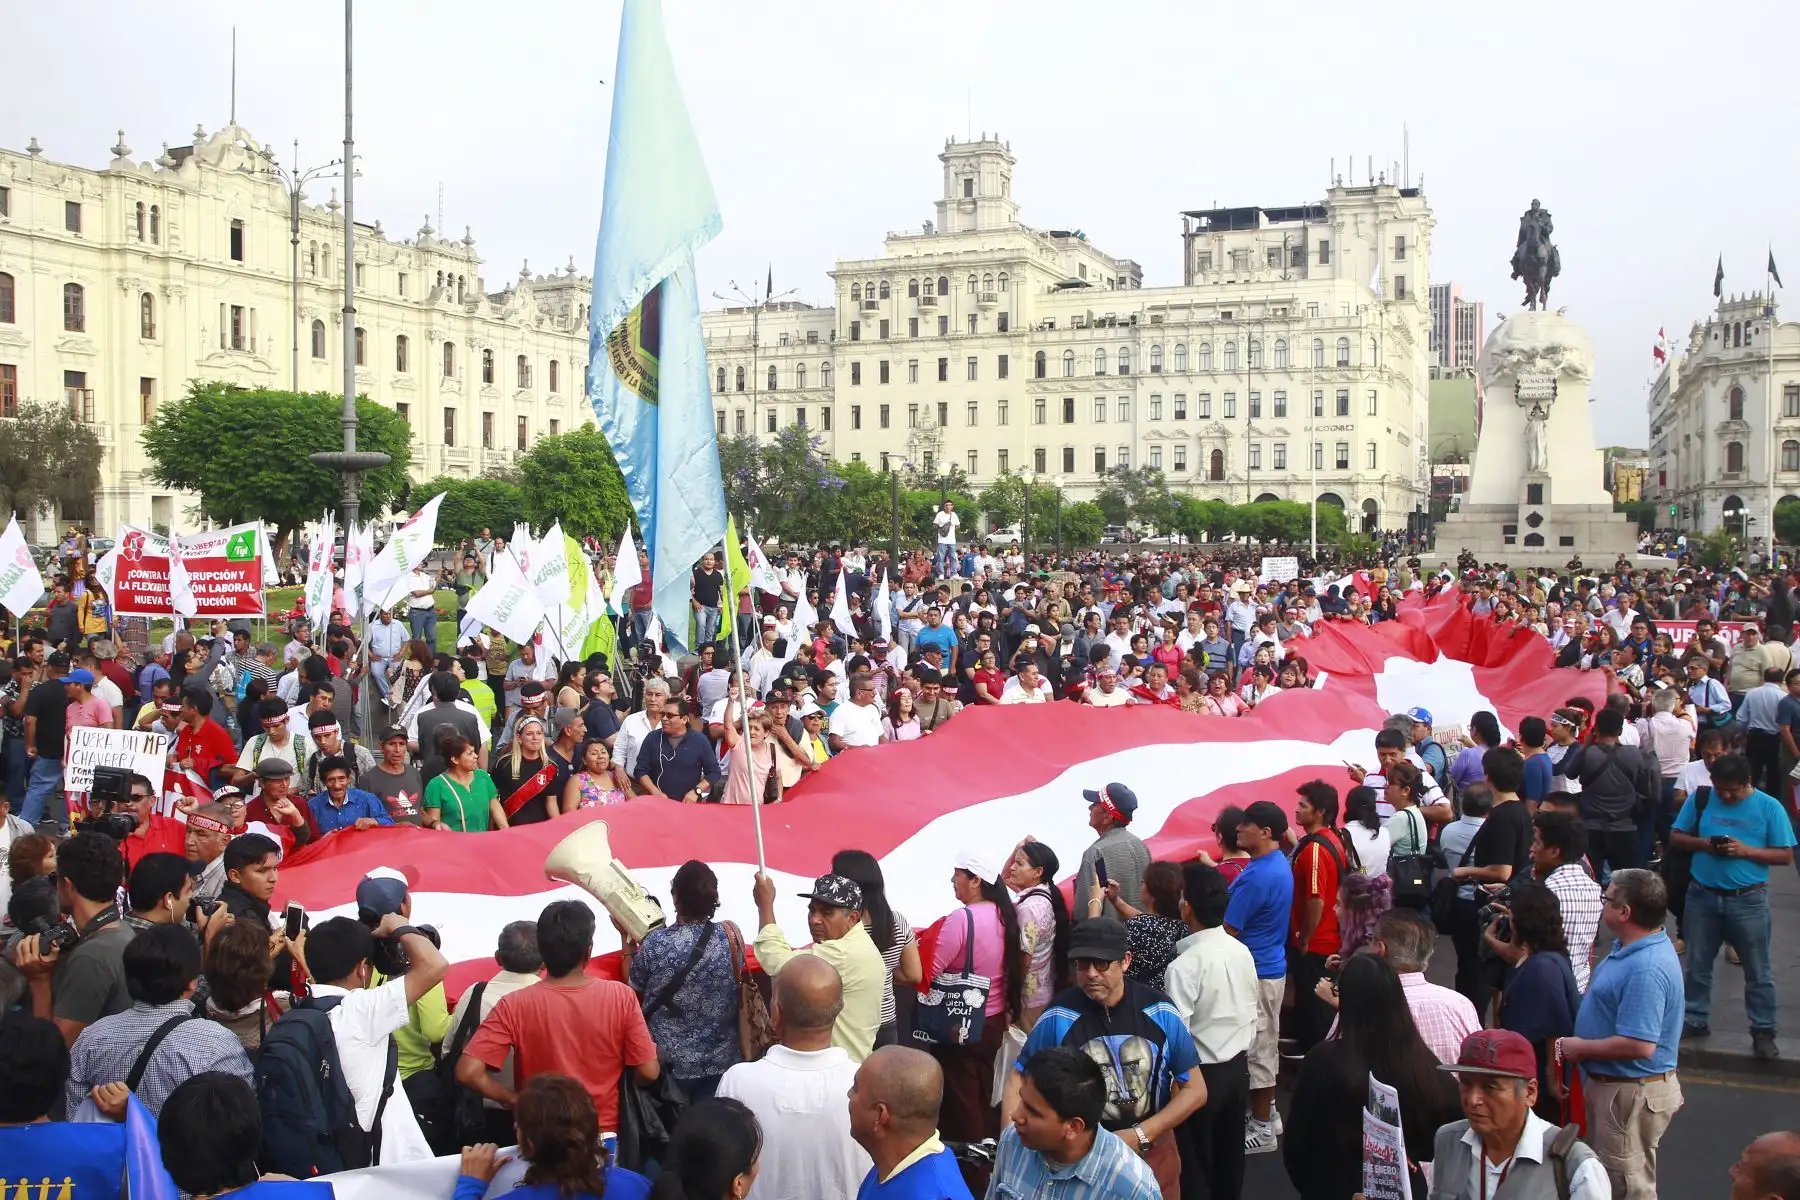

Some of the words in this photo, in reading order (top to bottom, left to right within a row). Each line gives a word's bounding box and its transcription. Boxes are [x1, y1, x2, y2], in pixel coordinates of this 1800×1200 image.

[612, 349, 627, 374] LEYES
[624, 371, 631, 380] Y
[628, 376, 639, 389] LA
[128, 569, 162, 580] ¡CONTRA
[239, 570, 246, 580] Y
[119, 580, 130, 590] LA
[208, 582, 256, 593] LABORAL
[134, 595, 163, 606] NUEVA
[75, 729, 112, 749] FUERA
[143, 734, 168, 755] MP
[947, 1006, 973, 1017] you!
